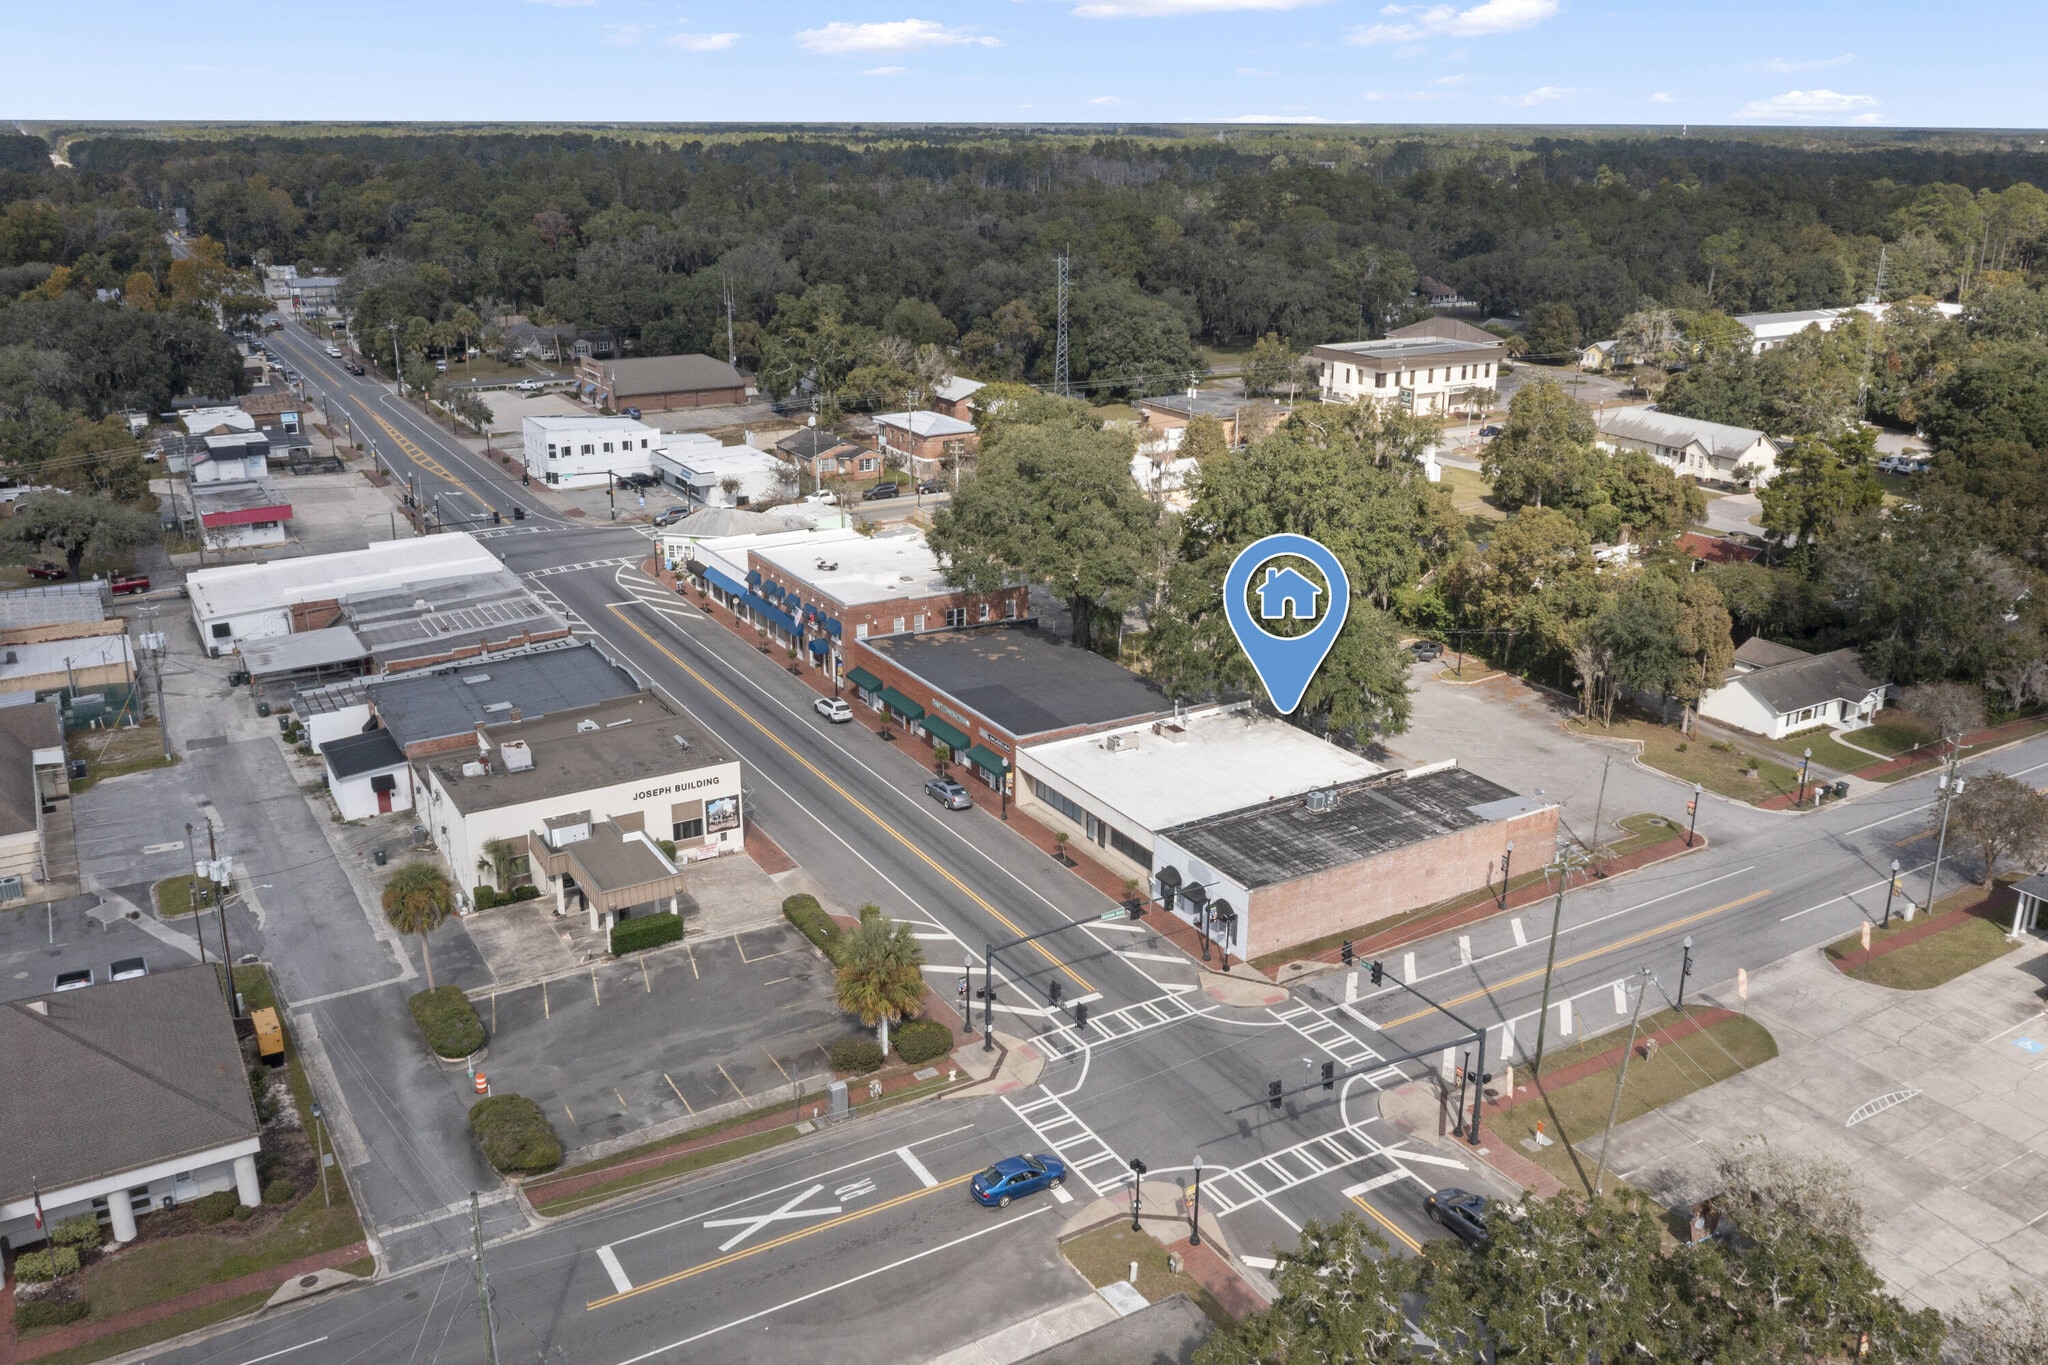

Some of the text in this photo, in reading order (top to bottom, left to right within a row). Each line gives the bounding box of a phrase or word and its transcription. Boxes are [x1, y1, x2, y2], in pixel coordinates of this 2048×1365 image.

[989, 735, 1010, 751] MUSEUM
[632, 776, 720, 801] JOSEPH BUILDING
